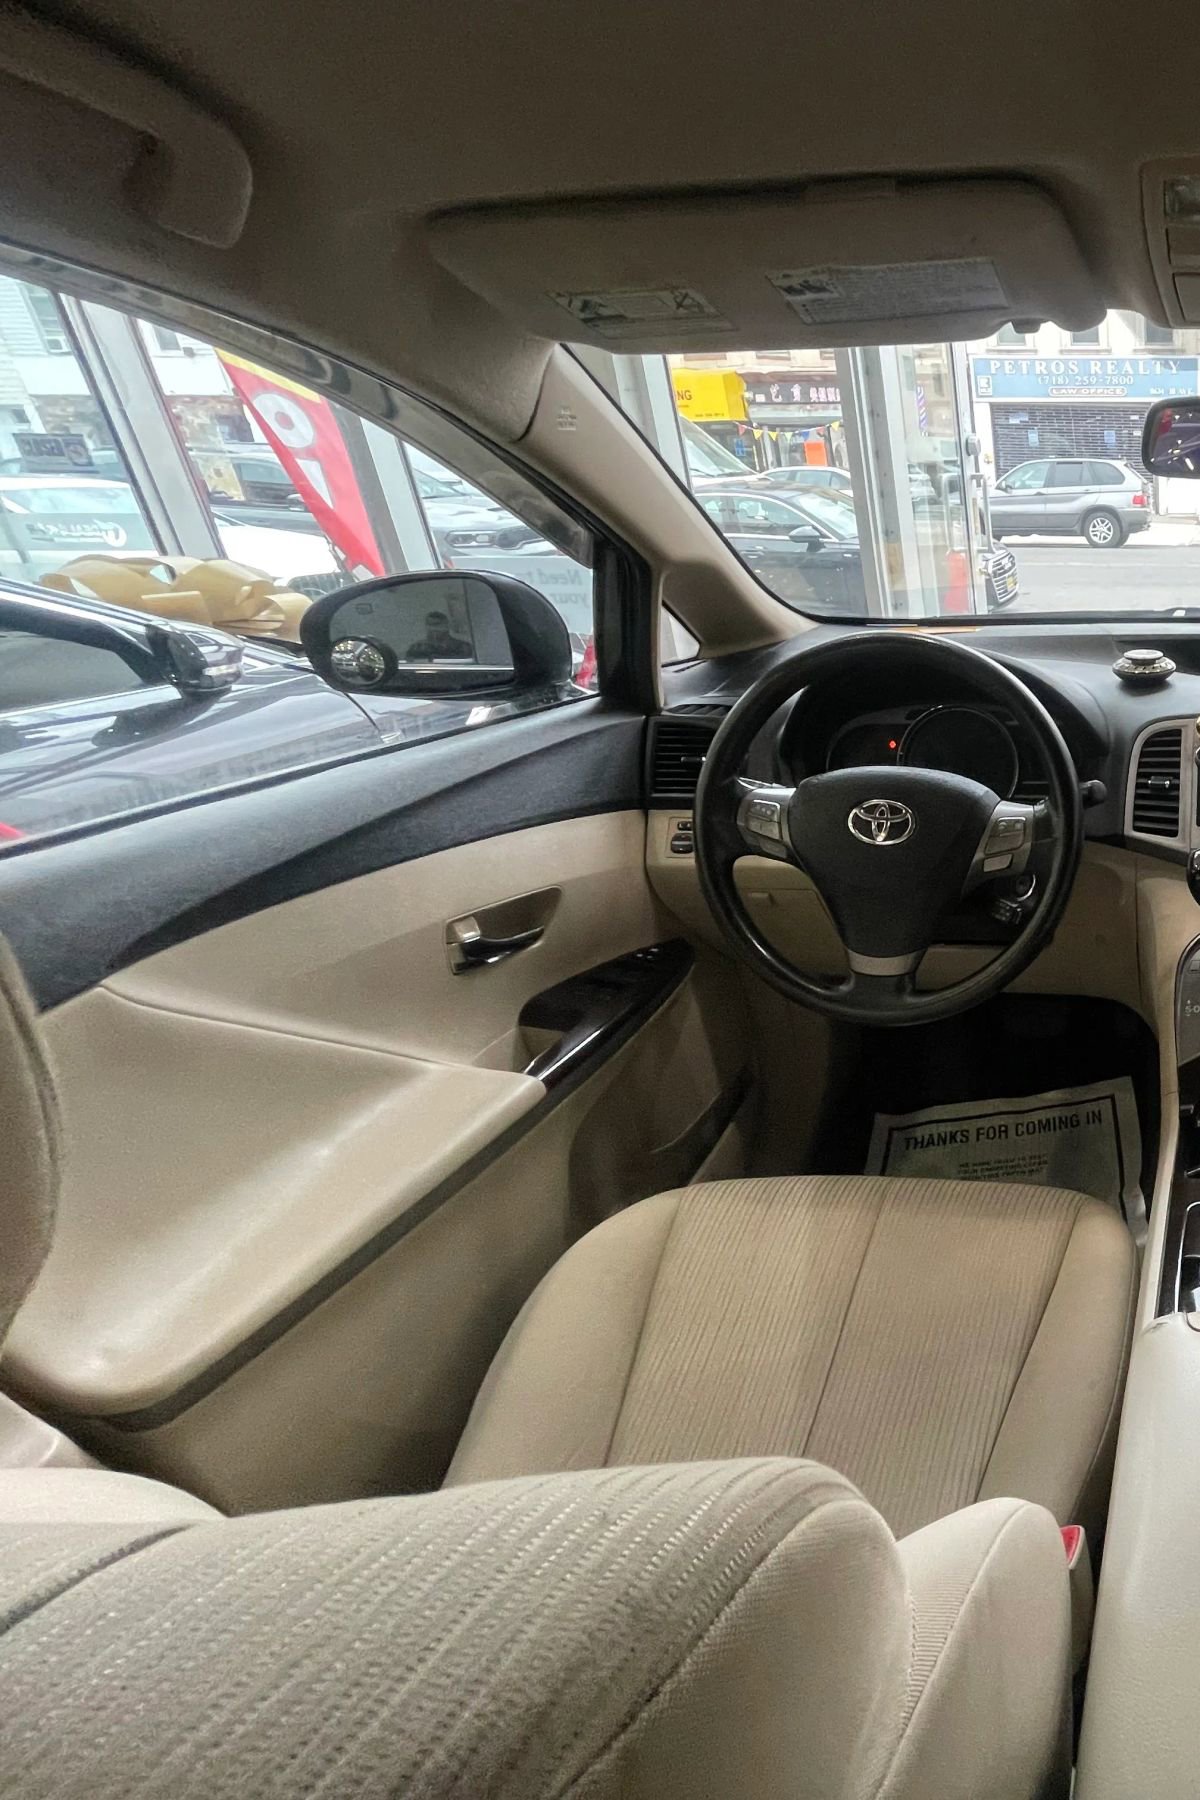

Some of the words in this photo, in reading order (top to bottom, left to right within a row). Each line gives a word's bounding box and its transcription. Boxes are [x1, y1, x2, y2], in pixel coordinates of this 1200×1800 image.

[990, 360, 1079, 375] PETROS
[1090, 360, 1181, 375] REALTY
[1038, 375, 1069, 386] (718)
[1075, 375, 1134, 386] 259-7800
[904, 1129, 970, 1151] THANKS
[976, 1124, 1009, 1142] FOR
[1014, 1113, 1081, 1138] COMING
[1086, 1109, 1104, 1126] IN
